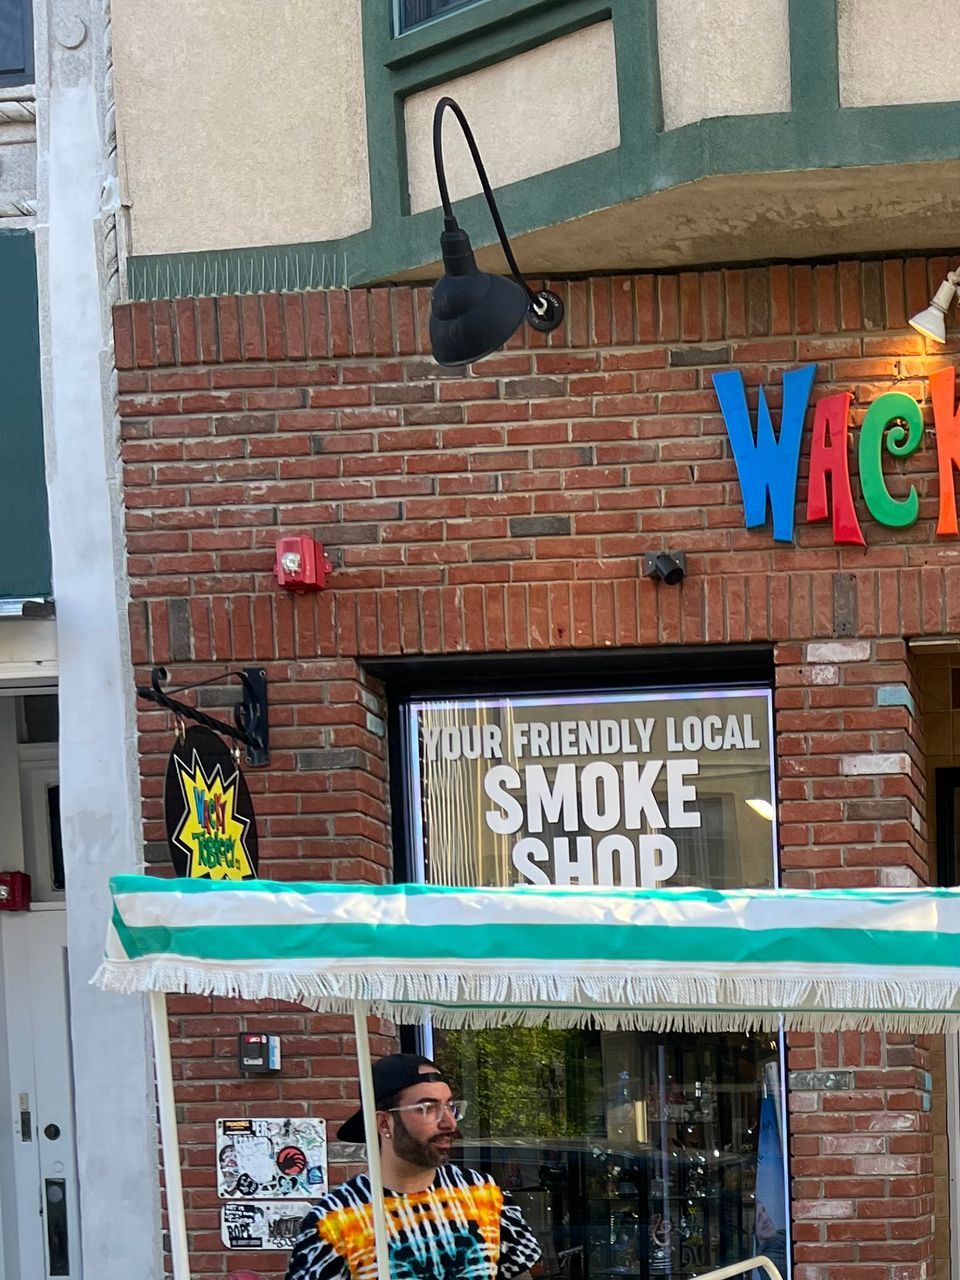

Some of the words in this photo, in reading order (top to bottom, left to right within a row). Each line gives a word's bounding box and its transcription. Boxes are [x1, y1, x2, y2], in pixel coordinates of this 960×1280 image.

[421, 724, 503, 761] YOUR
[513, 718, 656, 757] FRIENDLY
[666, 714, 760, 752] LOCAL
[193, 786, 226, 835] WACKY
[484, 759, 701, 834] SMOKE
[512, 834, 679, 887] SHOP
